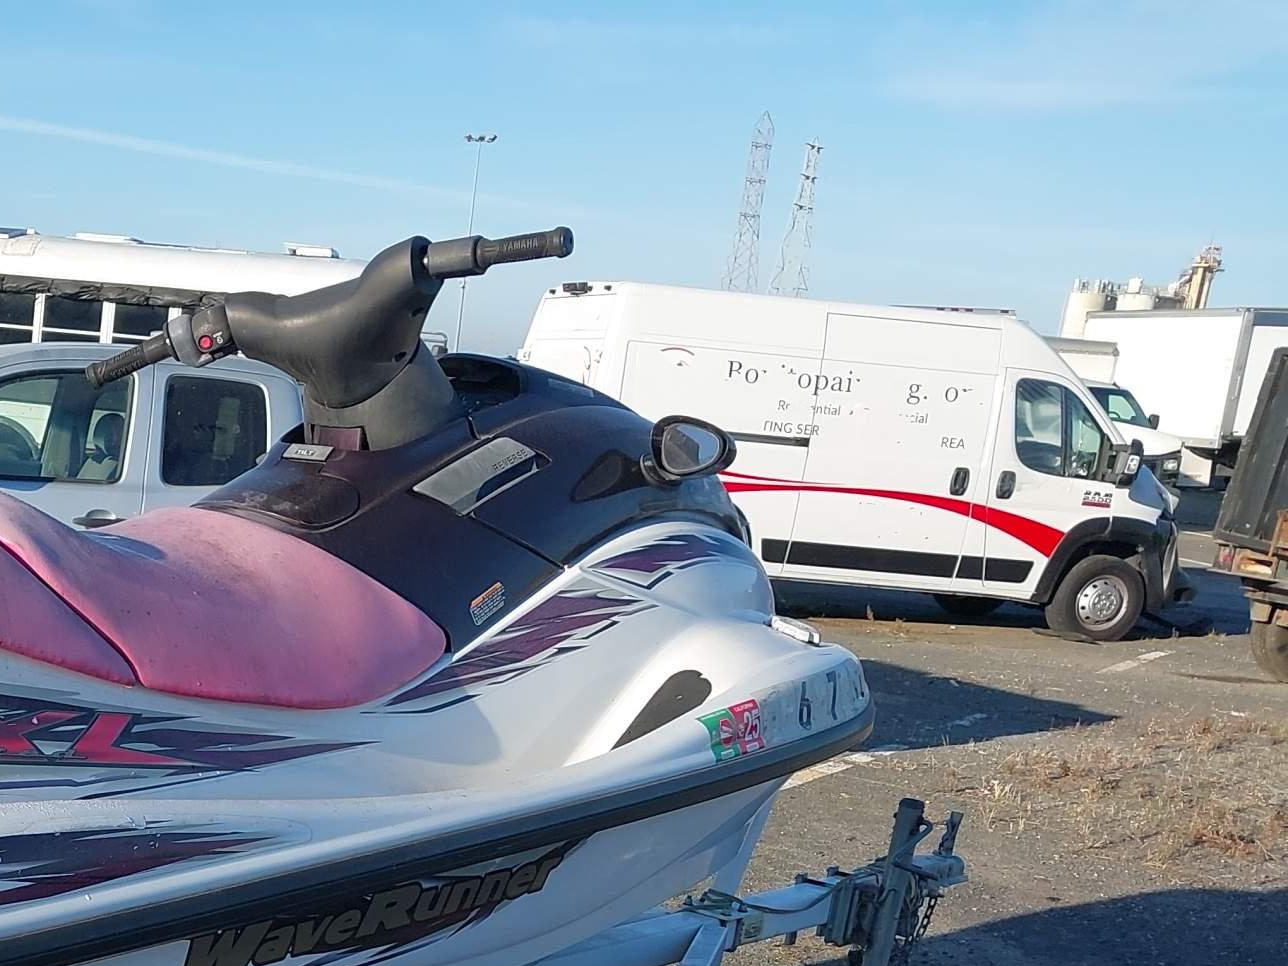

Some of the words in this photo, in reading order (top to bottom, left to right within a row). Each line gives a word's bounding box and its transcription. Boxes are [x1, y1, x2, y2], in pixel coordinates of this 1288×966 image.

[503, 238, 539, 252] YAMAHA
[940, 436, 966, 449] REA
[491, 449, 529, 472] REVERSE
